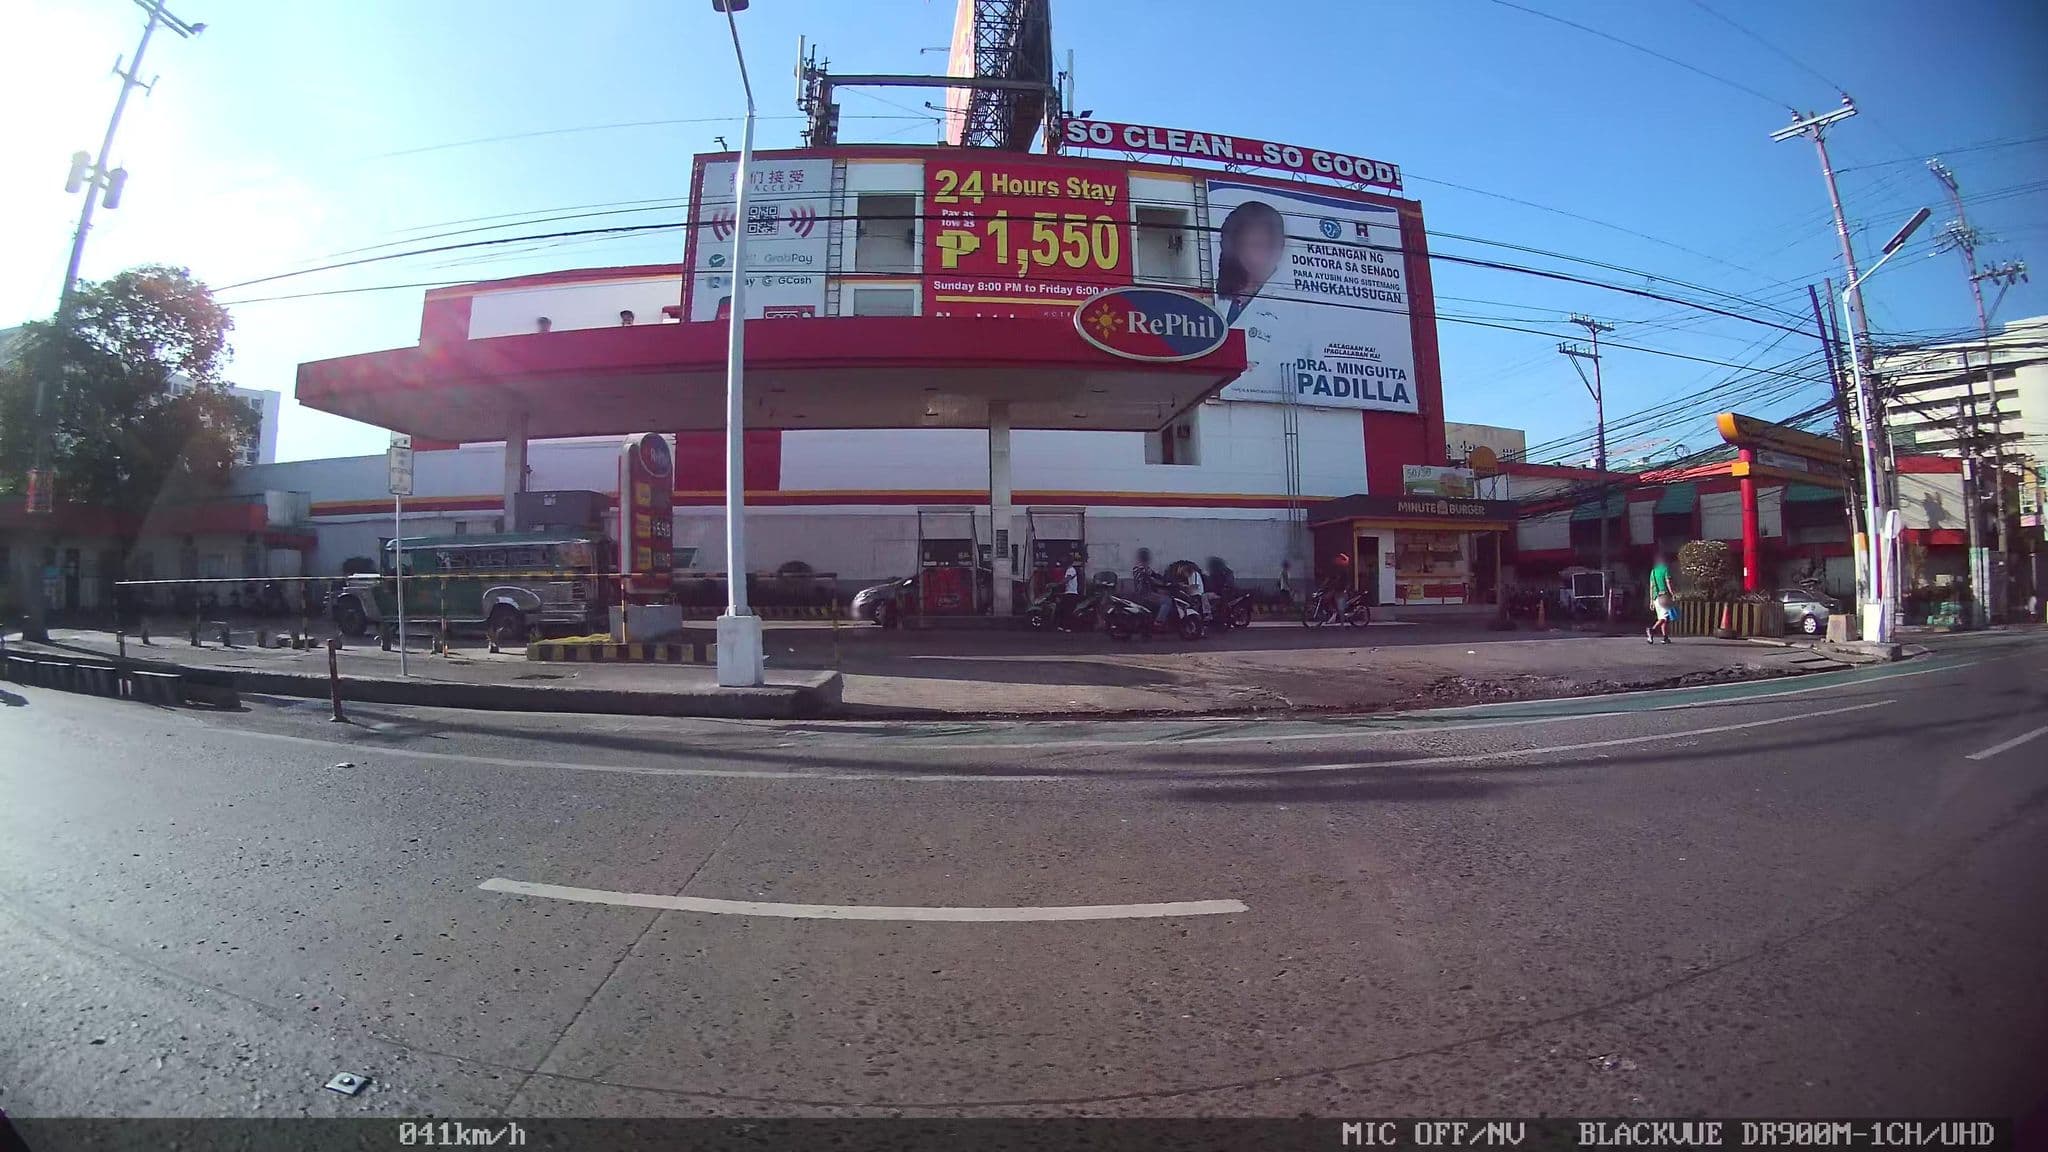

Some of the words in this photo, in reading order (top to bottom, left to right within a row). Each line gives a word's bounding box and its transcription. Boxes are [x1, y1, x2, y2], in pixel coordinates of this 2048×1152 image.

[1066, 120, 1113, 145] SO
[1311, 156, 1402, 184] GOOD!
[934, 169, 985, 204] 24
[991, 173, 1060, 197] Hours
[1066, 176, 1117, 206] Stay
[963, 220, 976, 228] as
[763, 253, 813, 265] GrabPay
[1306, 243, 1368, 263] KAILANGAN
[1369, 252, 1385, 264] NG
[1291, 254, 1343, 271] DOKTORA
[1344, 262, 1359, 273] SA
[1360, 264, 1400, 279] SENADO
[777, 275, 812, 285] GCash
[933, 280, 975, 294] Sunday
[977, 281, 1002, 292] 8:00
[1005, 282, 1022, 293] PM
[1025, 283, 1037, 294] to
[1039, 284, 1073, 297] Friday
[1076, 286, 1099, 296] 6:00
[1293, 269, 1313, 279] PARA
[1314, 272, 1342, 283] AYUSIN
[1343, 276, 1360, 286] ANG
[1360, 278, 1400, 291] SISTEMANG
[1294, 279, 1402, 304] PANGKALUSUGAN
[1127, 311, 1216, 339] RePhil
[1297, 358, 1332, 373] DRA.
[1336, 362, 1407, 381] MINGUITA
[1297, 373, 1411, 404] PADILLA
[1398, 501, 1437, 514] MINUTE
[1449, 503, 1485, 516] BURGER
